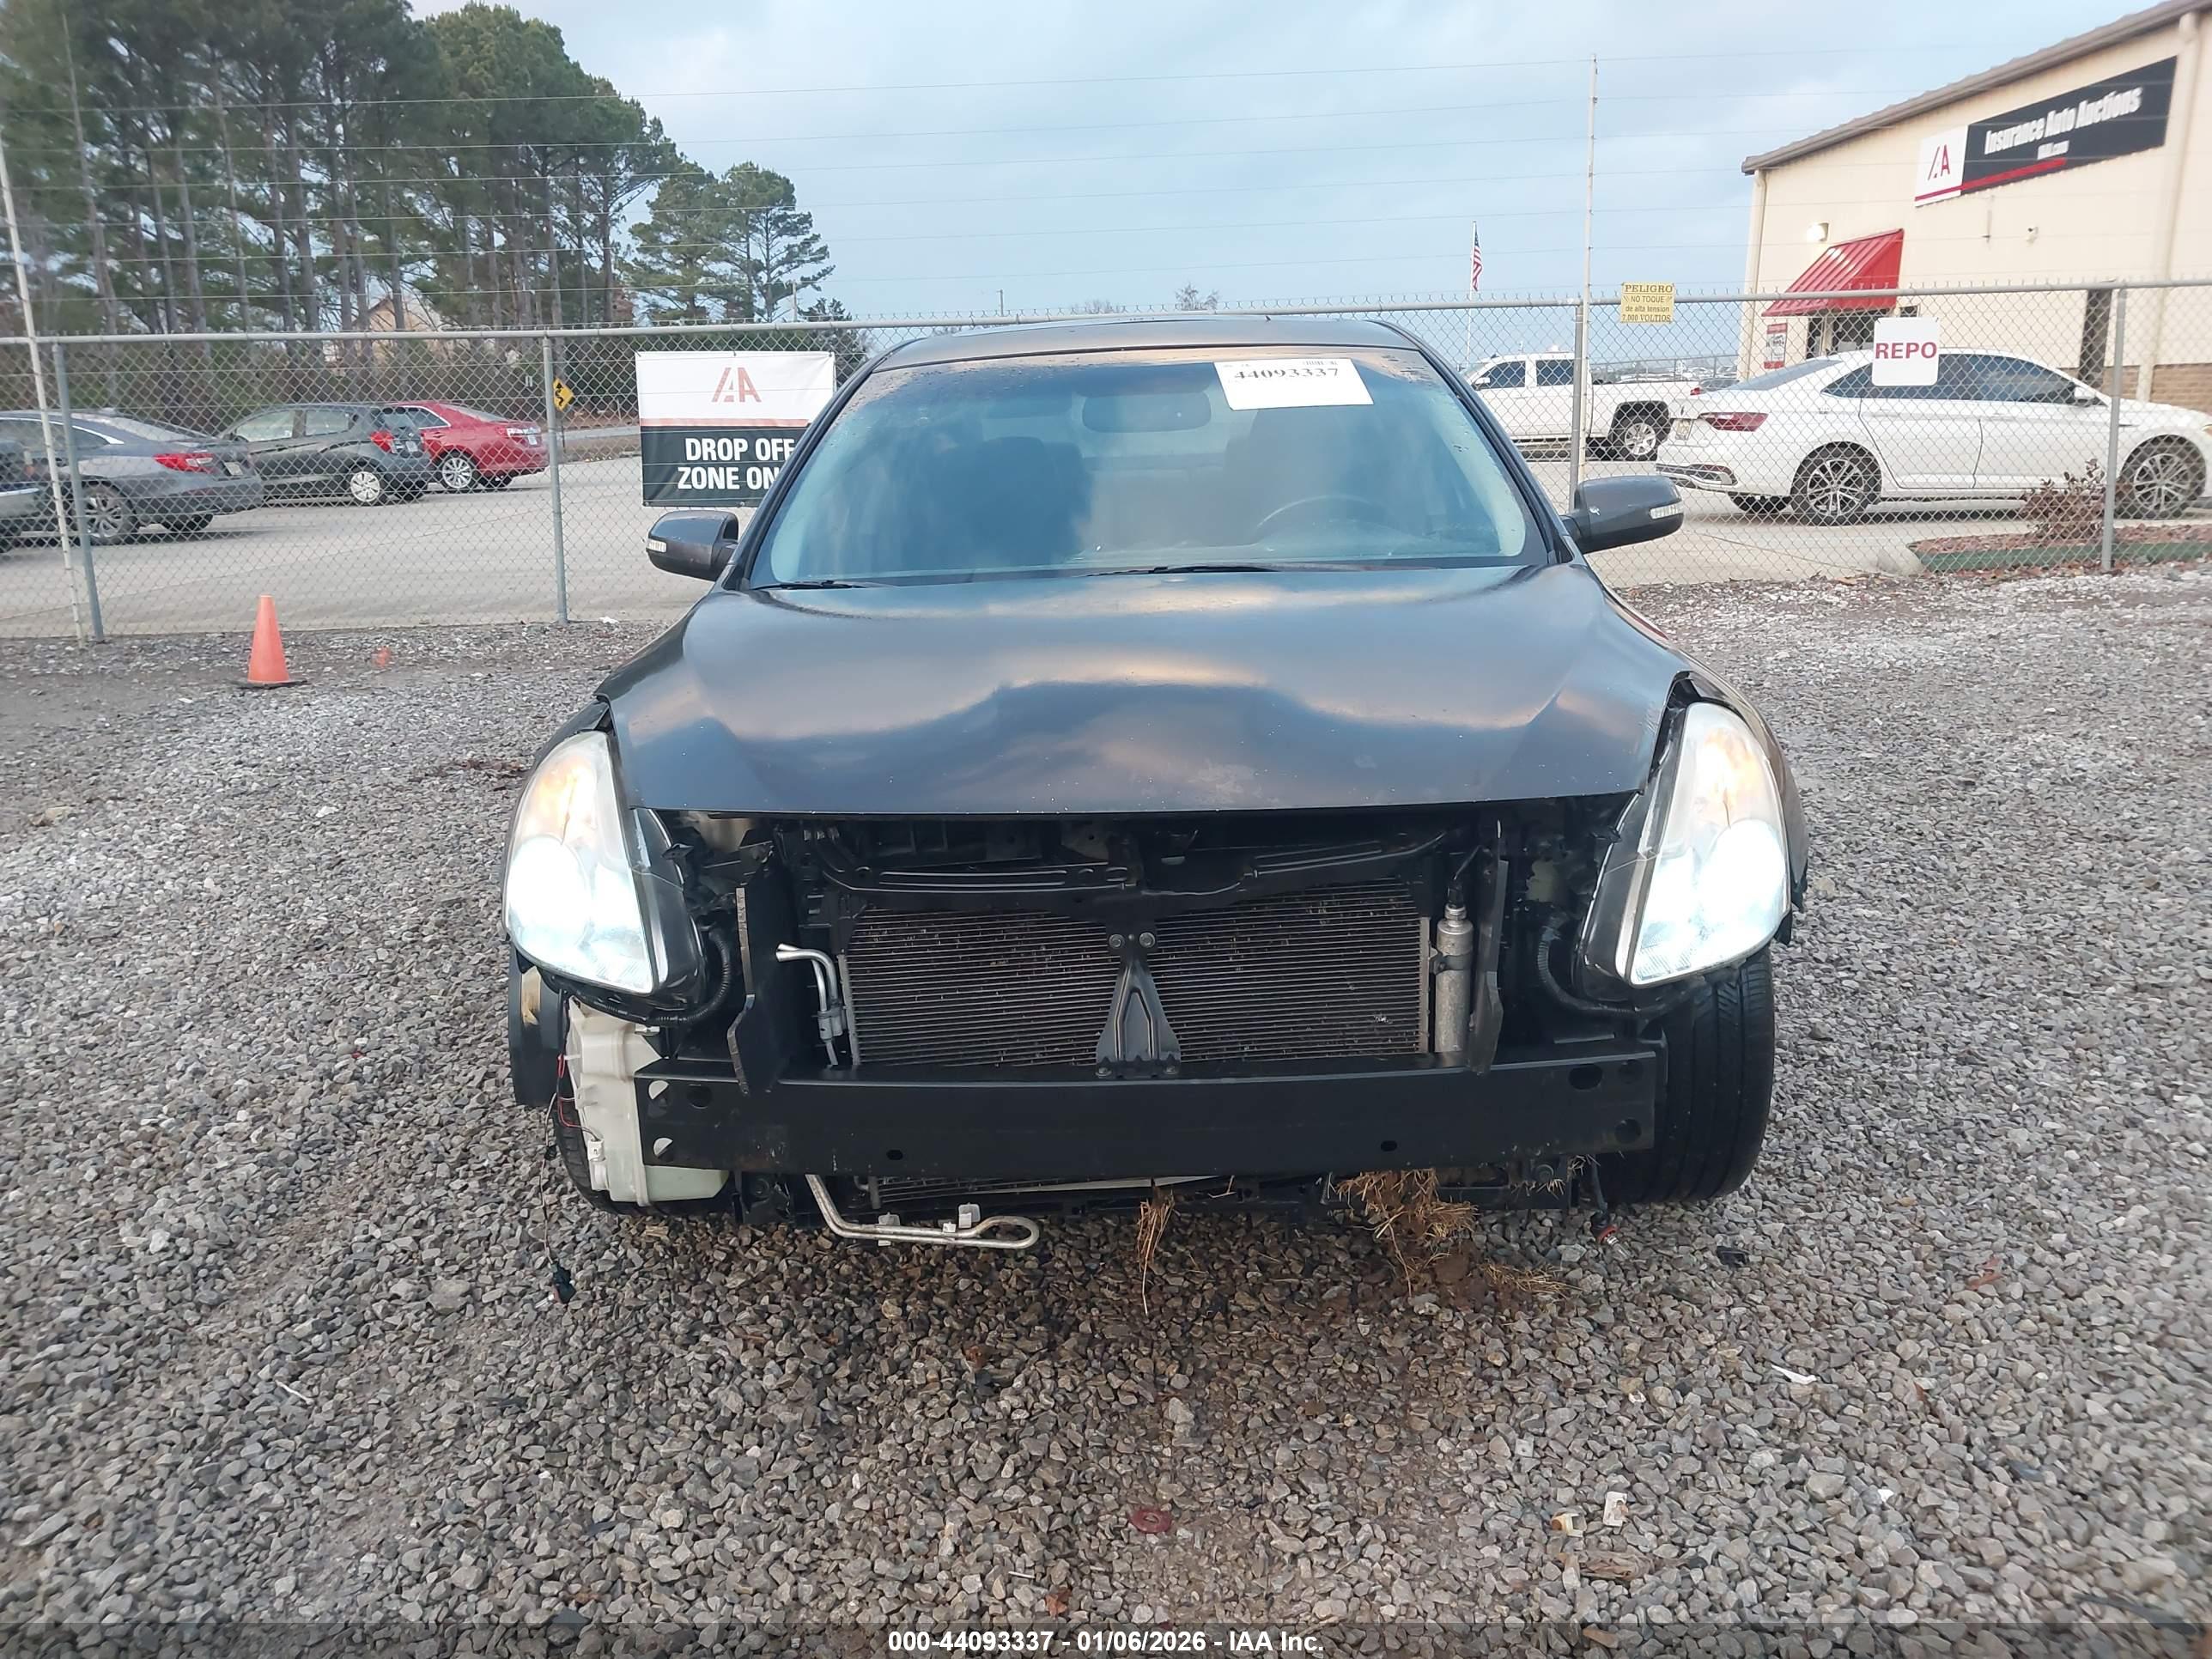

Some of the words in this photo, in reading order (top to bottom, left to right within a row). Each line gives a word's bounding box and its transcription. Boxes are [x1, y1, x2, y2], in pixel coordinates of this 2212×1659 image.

[1984, 118, 2045, 155] Insurance
[2045, 106, 2076, 137] Auto
[2075, 87, 2143, 129] Auctions
[1625, 284, 1673, 293] PELIGRO
[1875, 342, 1937, 359] REPO
[1234, 368, 1338, 379] 44093337
[685, 438, 748, 461] DROP
[755, 438, 795, 461] OFF
[678, 466, 739, 489] ZONE
